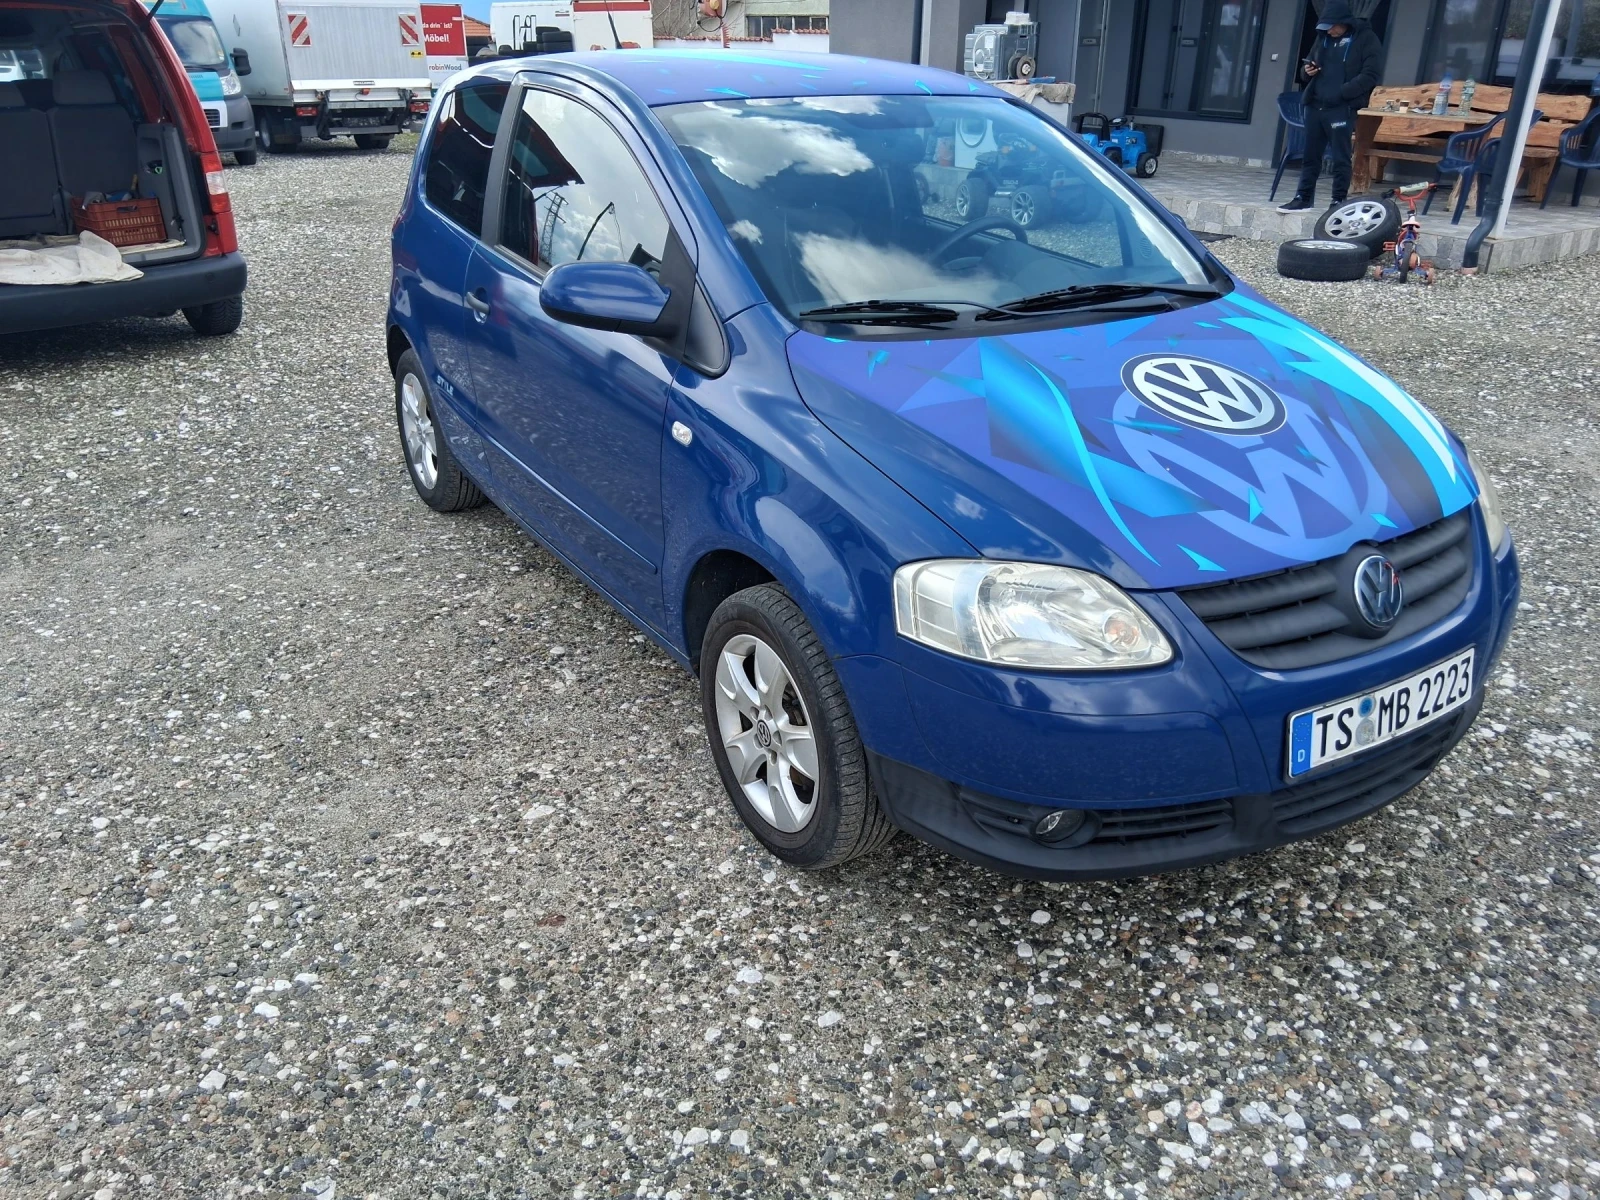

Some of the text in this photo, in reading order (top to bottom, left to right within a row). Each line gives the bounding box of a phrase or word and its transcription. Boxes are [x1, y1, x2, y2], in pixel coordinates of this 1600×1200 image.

[429, 63, 462, 71] robinWood
[436, 374, 454, 396] STYLE
[1315, 655, 1471, 758] TS MB 2223
[1297, 748, 1305, 763] D
